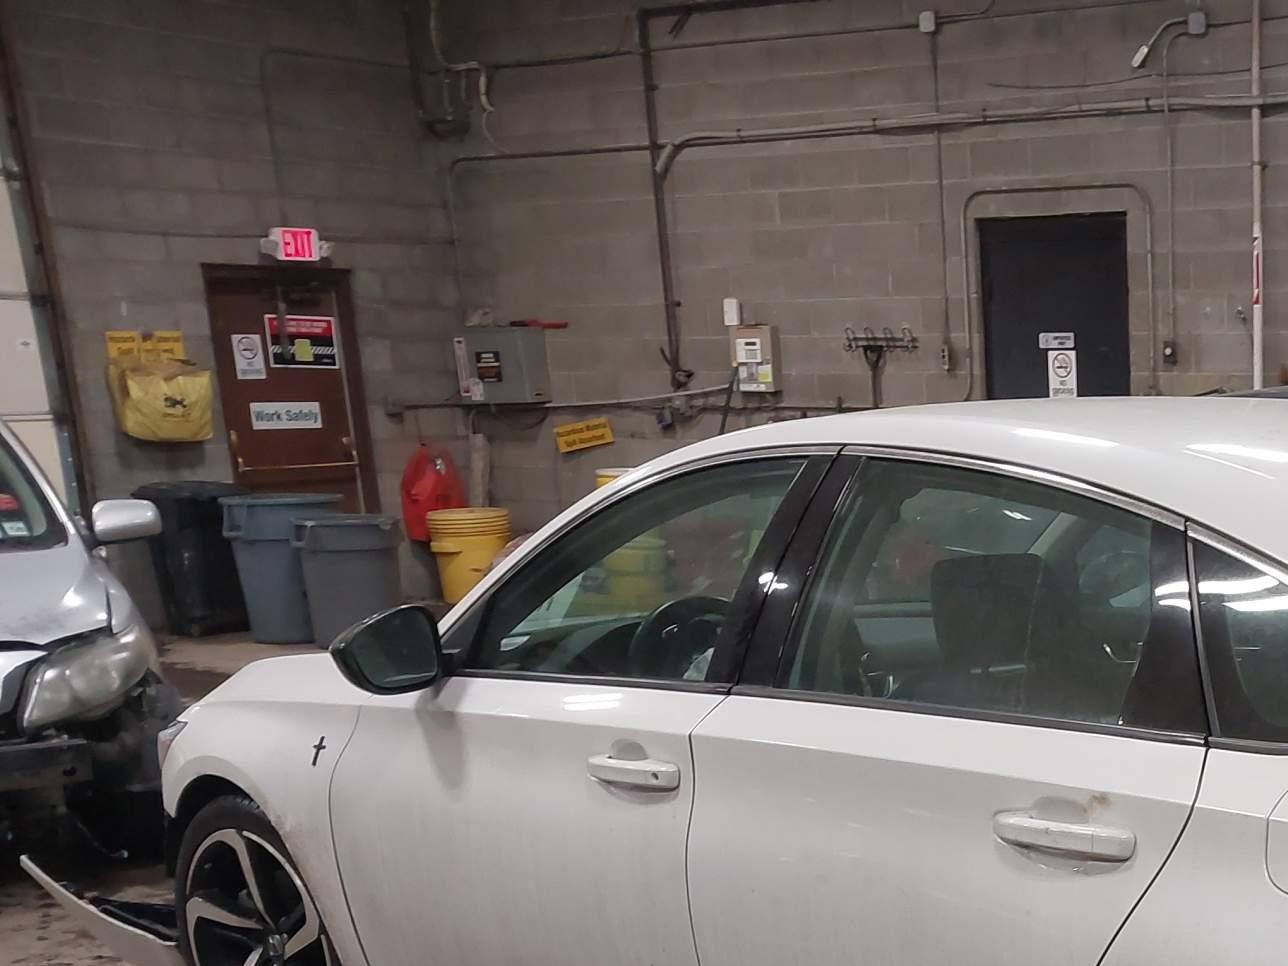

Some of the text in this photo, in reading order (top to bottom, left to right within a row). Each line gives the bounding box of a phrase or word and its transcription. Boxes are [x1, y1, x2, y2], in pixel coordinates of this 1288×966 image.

[282, 230, 313, 257] EXIT
[254, 409, 319, 423] Work Safely
